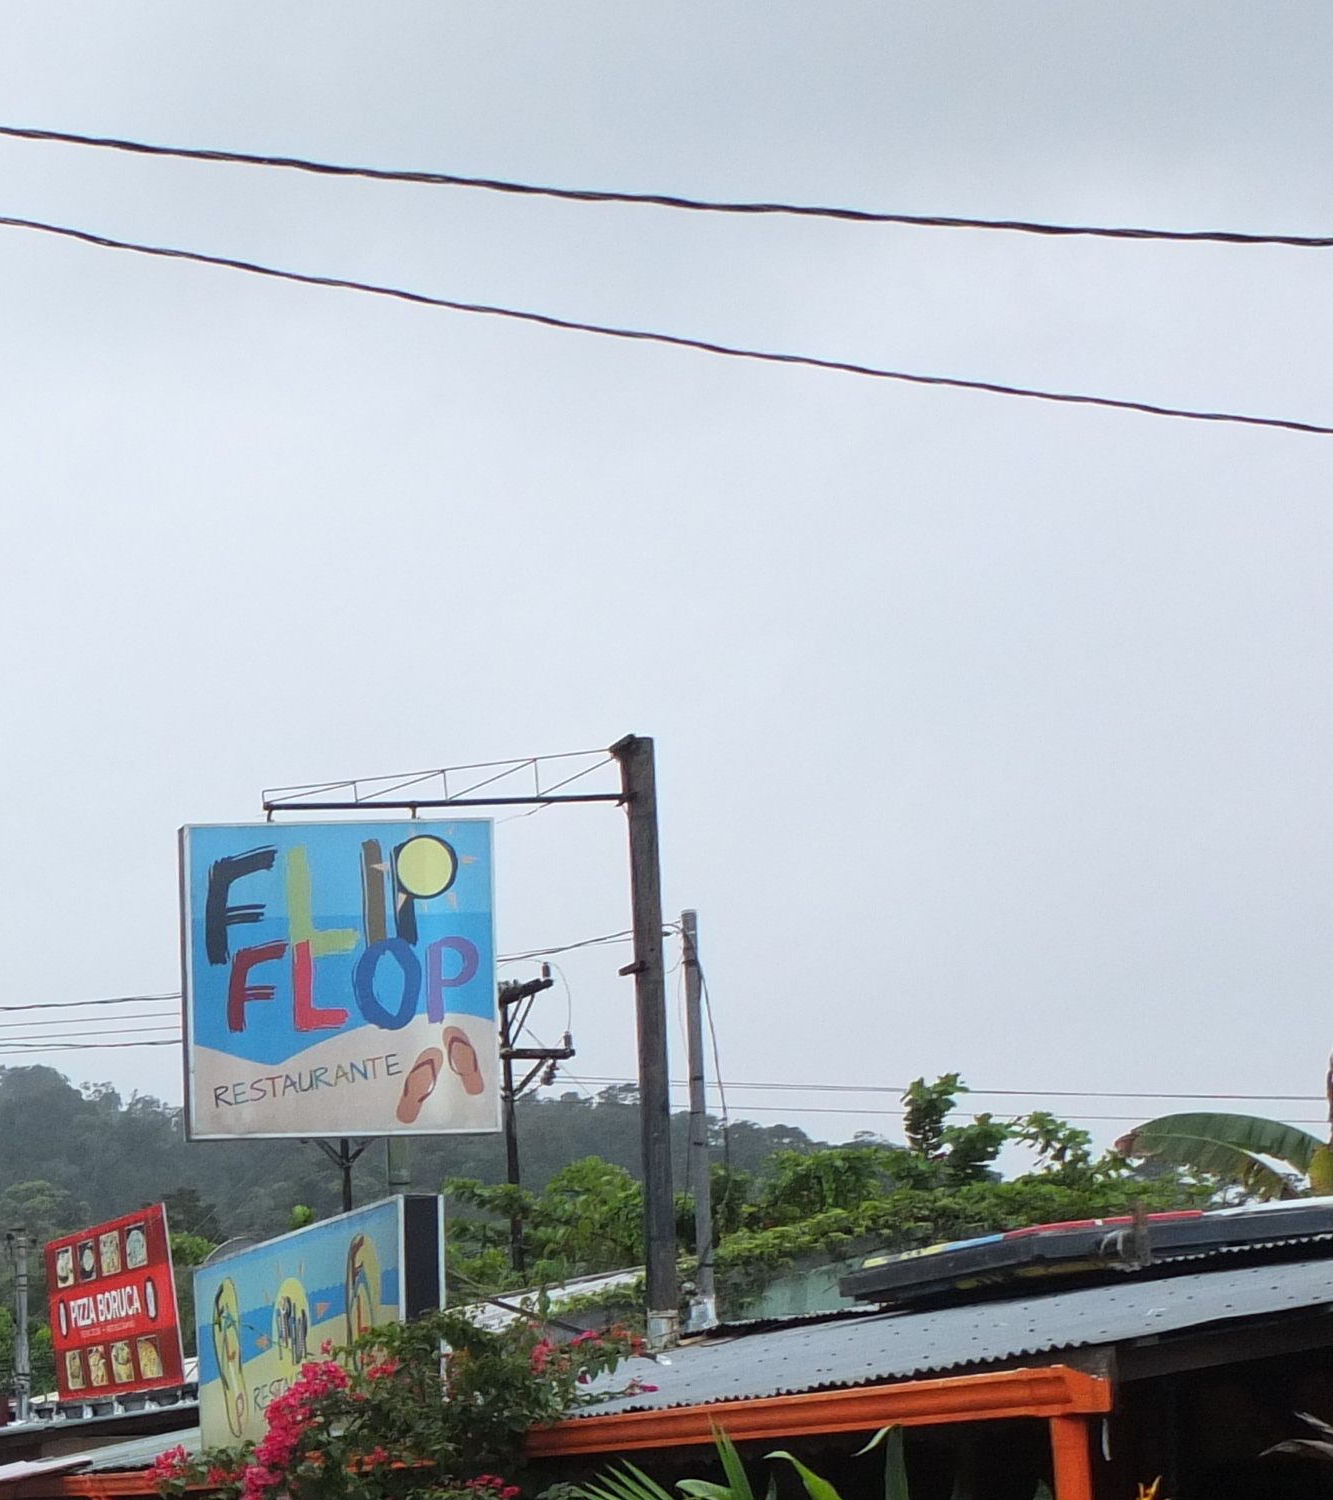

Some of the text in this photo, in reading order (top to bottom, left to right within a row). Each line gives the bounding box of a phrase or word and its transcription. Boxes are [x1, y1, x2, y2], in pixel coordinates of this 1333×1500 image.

[204, 832, 459, 967] FLIP
[226, 935, 481, 1032] FLOP
[213, 1052, 405, 1109] RESTAURANTE
[69, 1285, 142, 1328] PIZZA BORUCA
